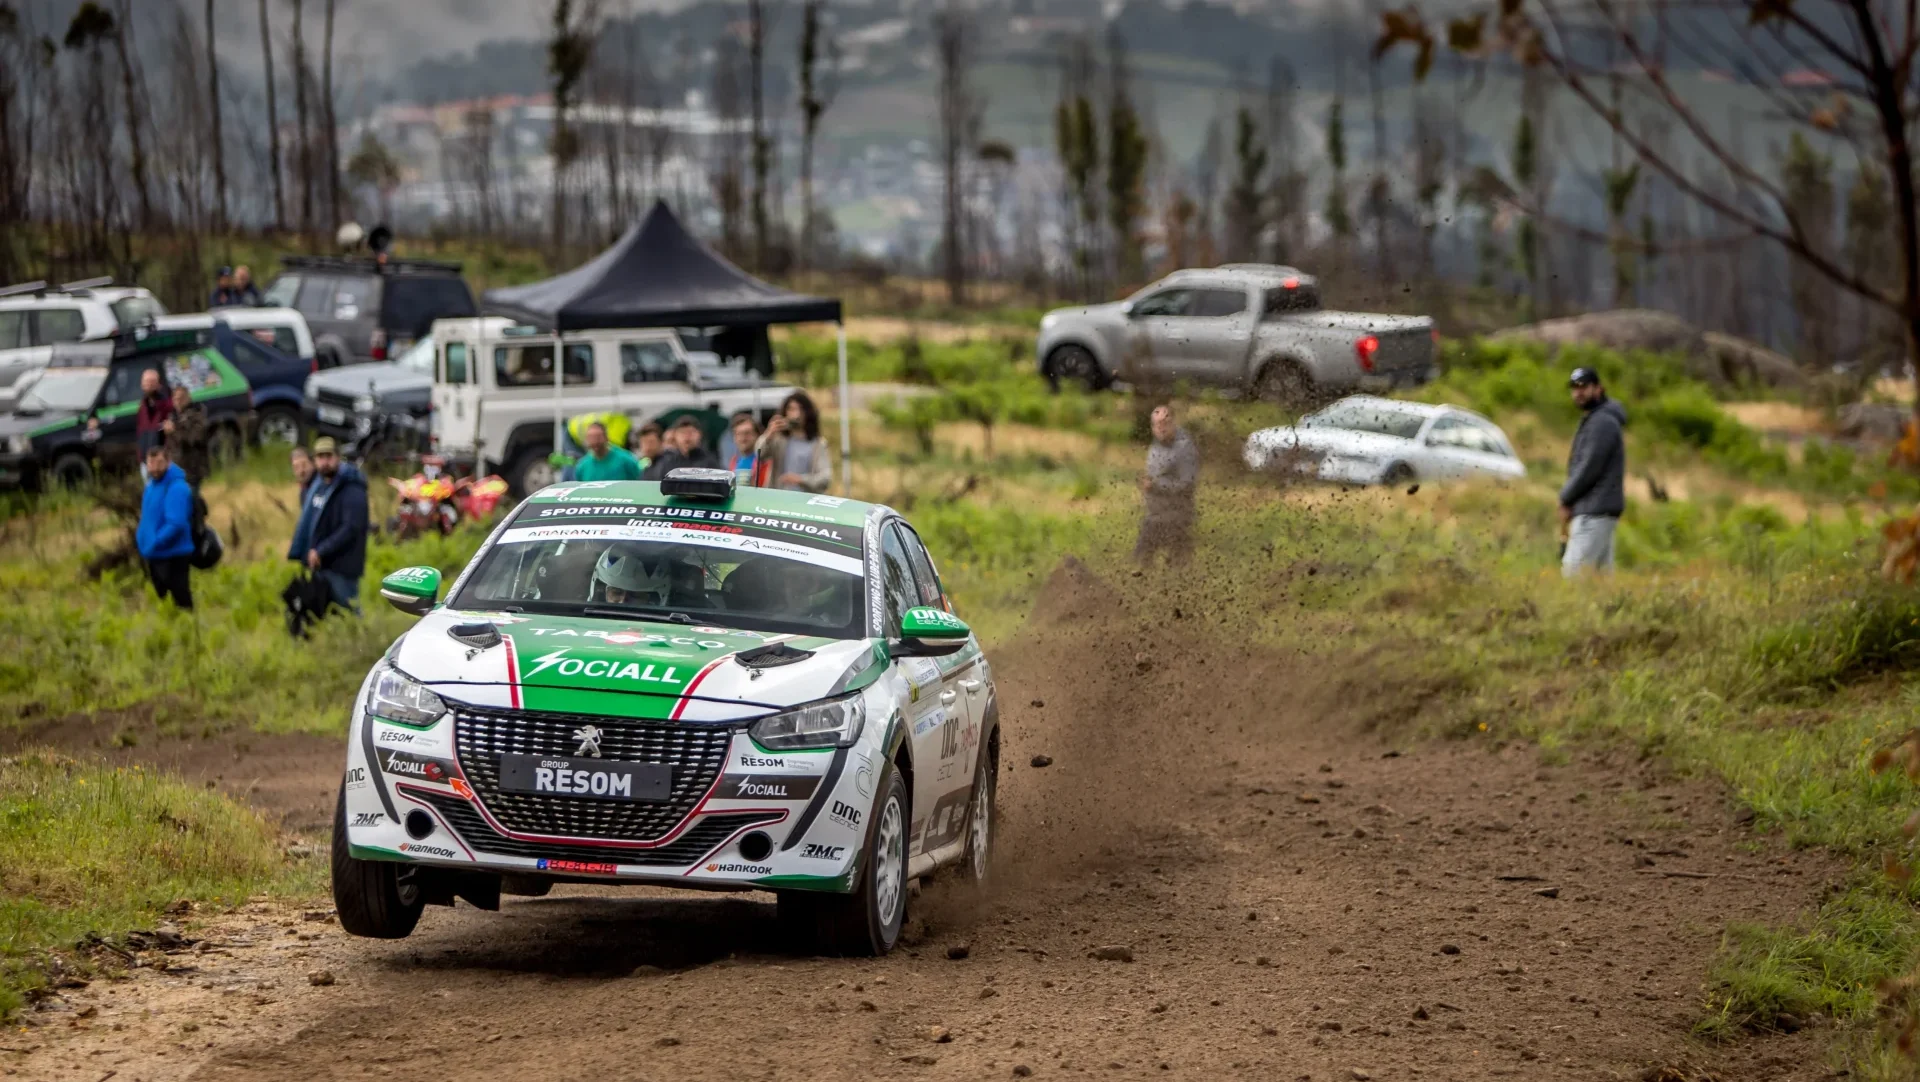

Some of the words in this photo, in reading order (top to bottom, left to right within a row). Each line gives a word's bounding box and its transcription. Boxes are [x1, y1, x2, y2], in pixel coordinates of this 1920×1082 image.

[540, 506, 638, 517] SPORTING
[641, 507, 705, 519] CLUBE
[709, 510, 737, 521] DE
[740, 514, 843, 541] PORTUGAL
[528, 529, 610, 537] AMARANTE
[871, 588, 883, 635] SPORTING
[379, 731, 415, 743] RESOM
[541, 760, 570, 769] GROUP
[740, 756, 785, 768] RESOM
[535, 767, 632, 797] RESOM
[353, 812, 385, 825] RMC
[803, 843, 846, 858] RMC
